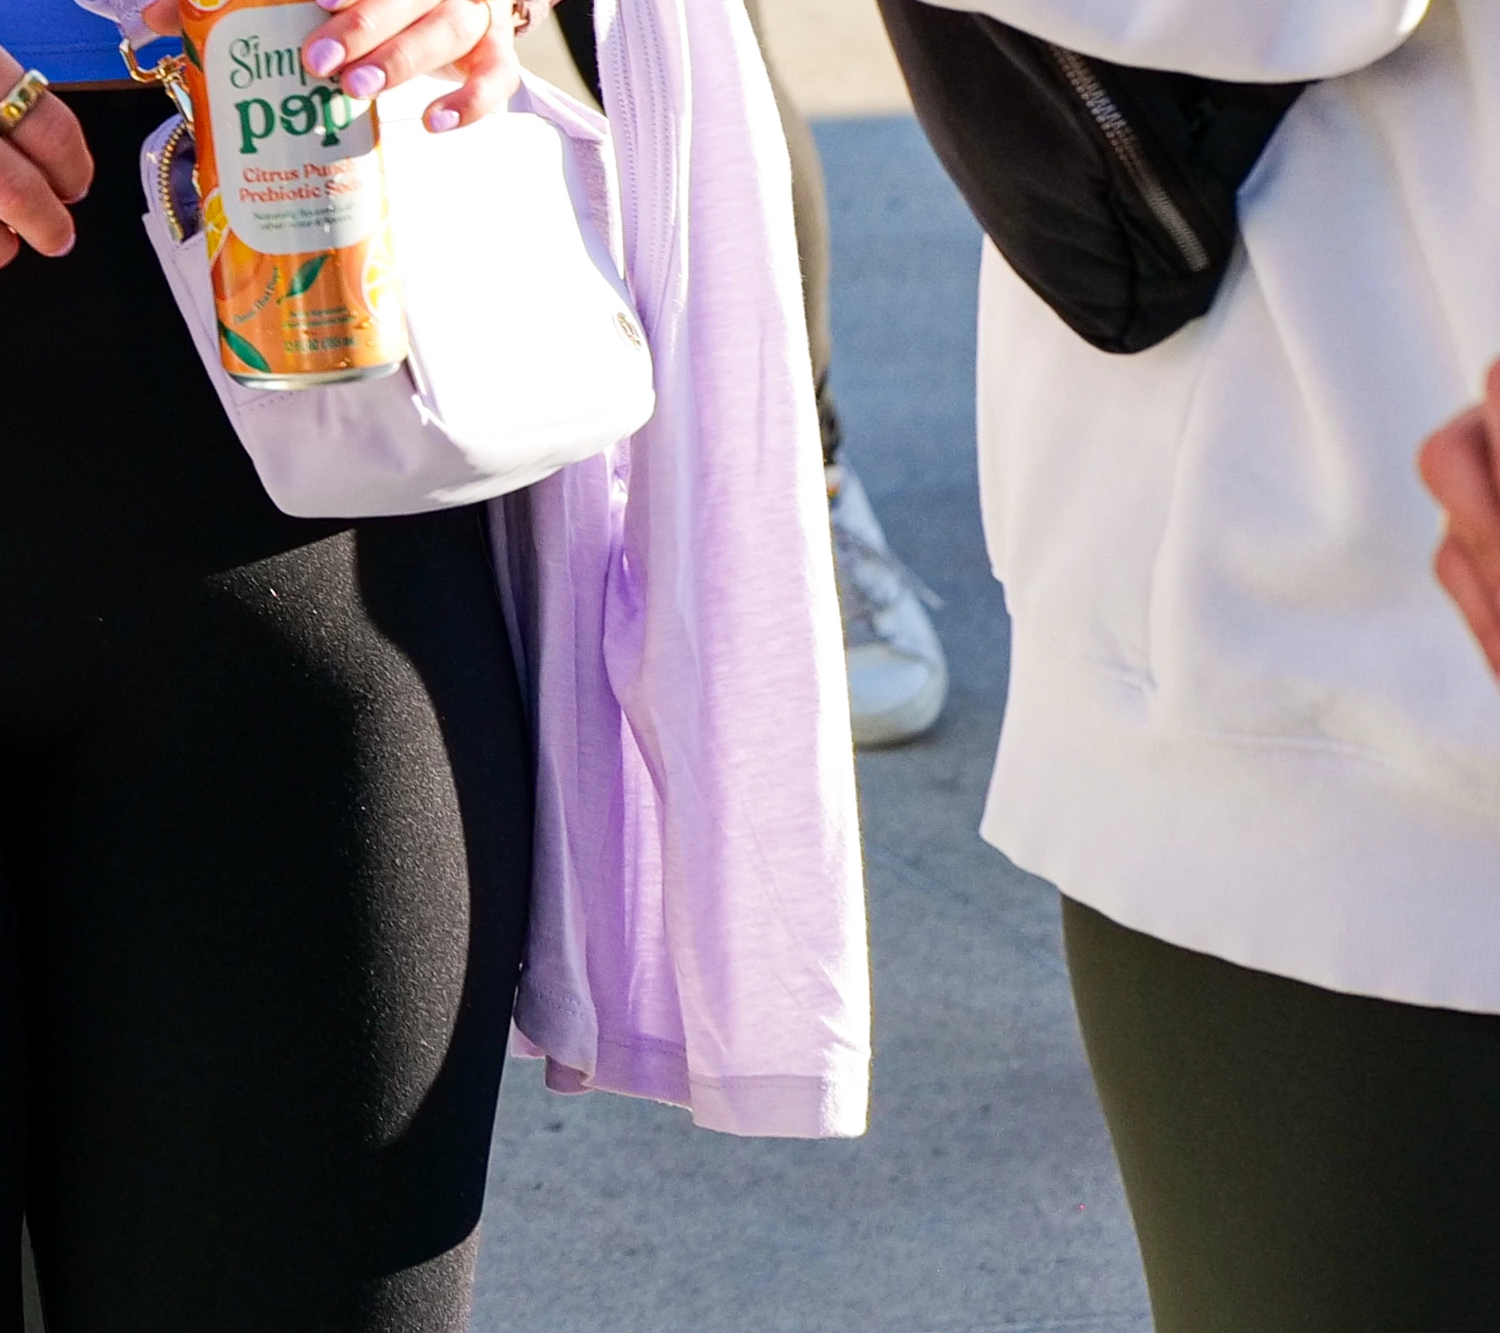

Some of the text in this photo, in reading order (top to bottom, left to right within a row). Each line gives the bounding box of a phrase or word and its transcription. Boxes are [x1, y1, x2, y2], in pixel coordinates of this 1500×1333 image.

[234, 85, 354, 155] pop
[242, 166, 300, 184] Citrus
[238, 183, 322, 204] Prebiotic
